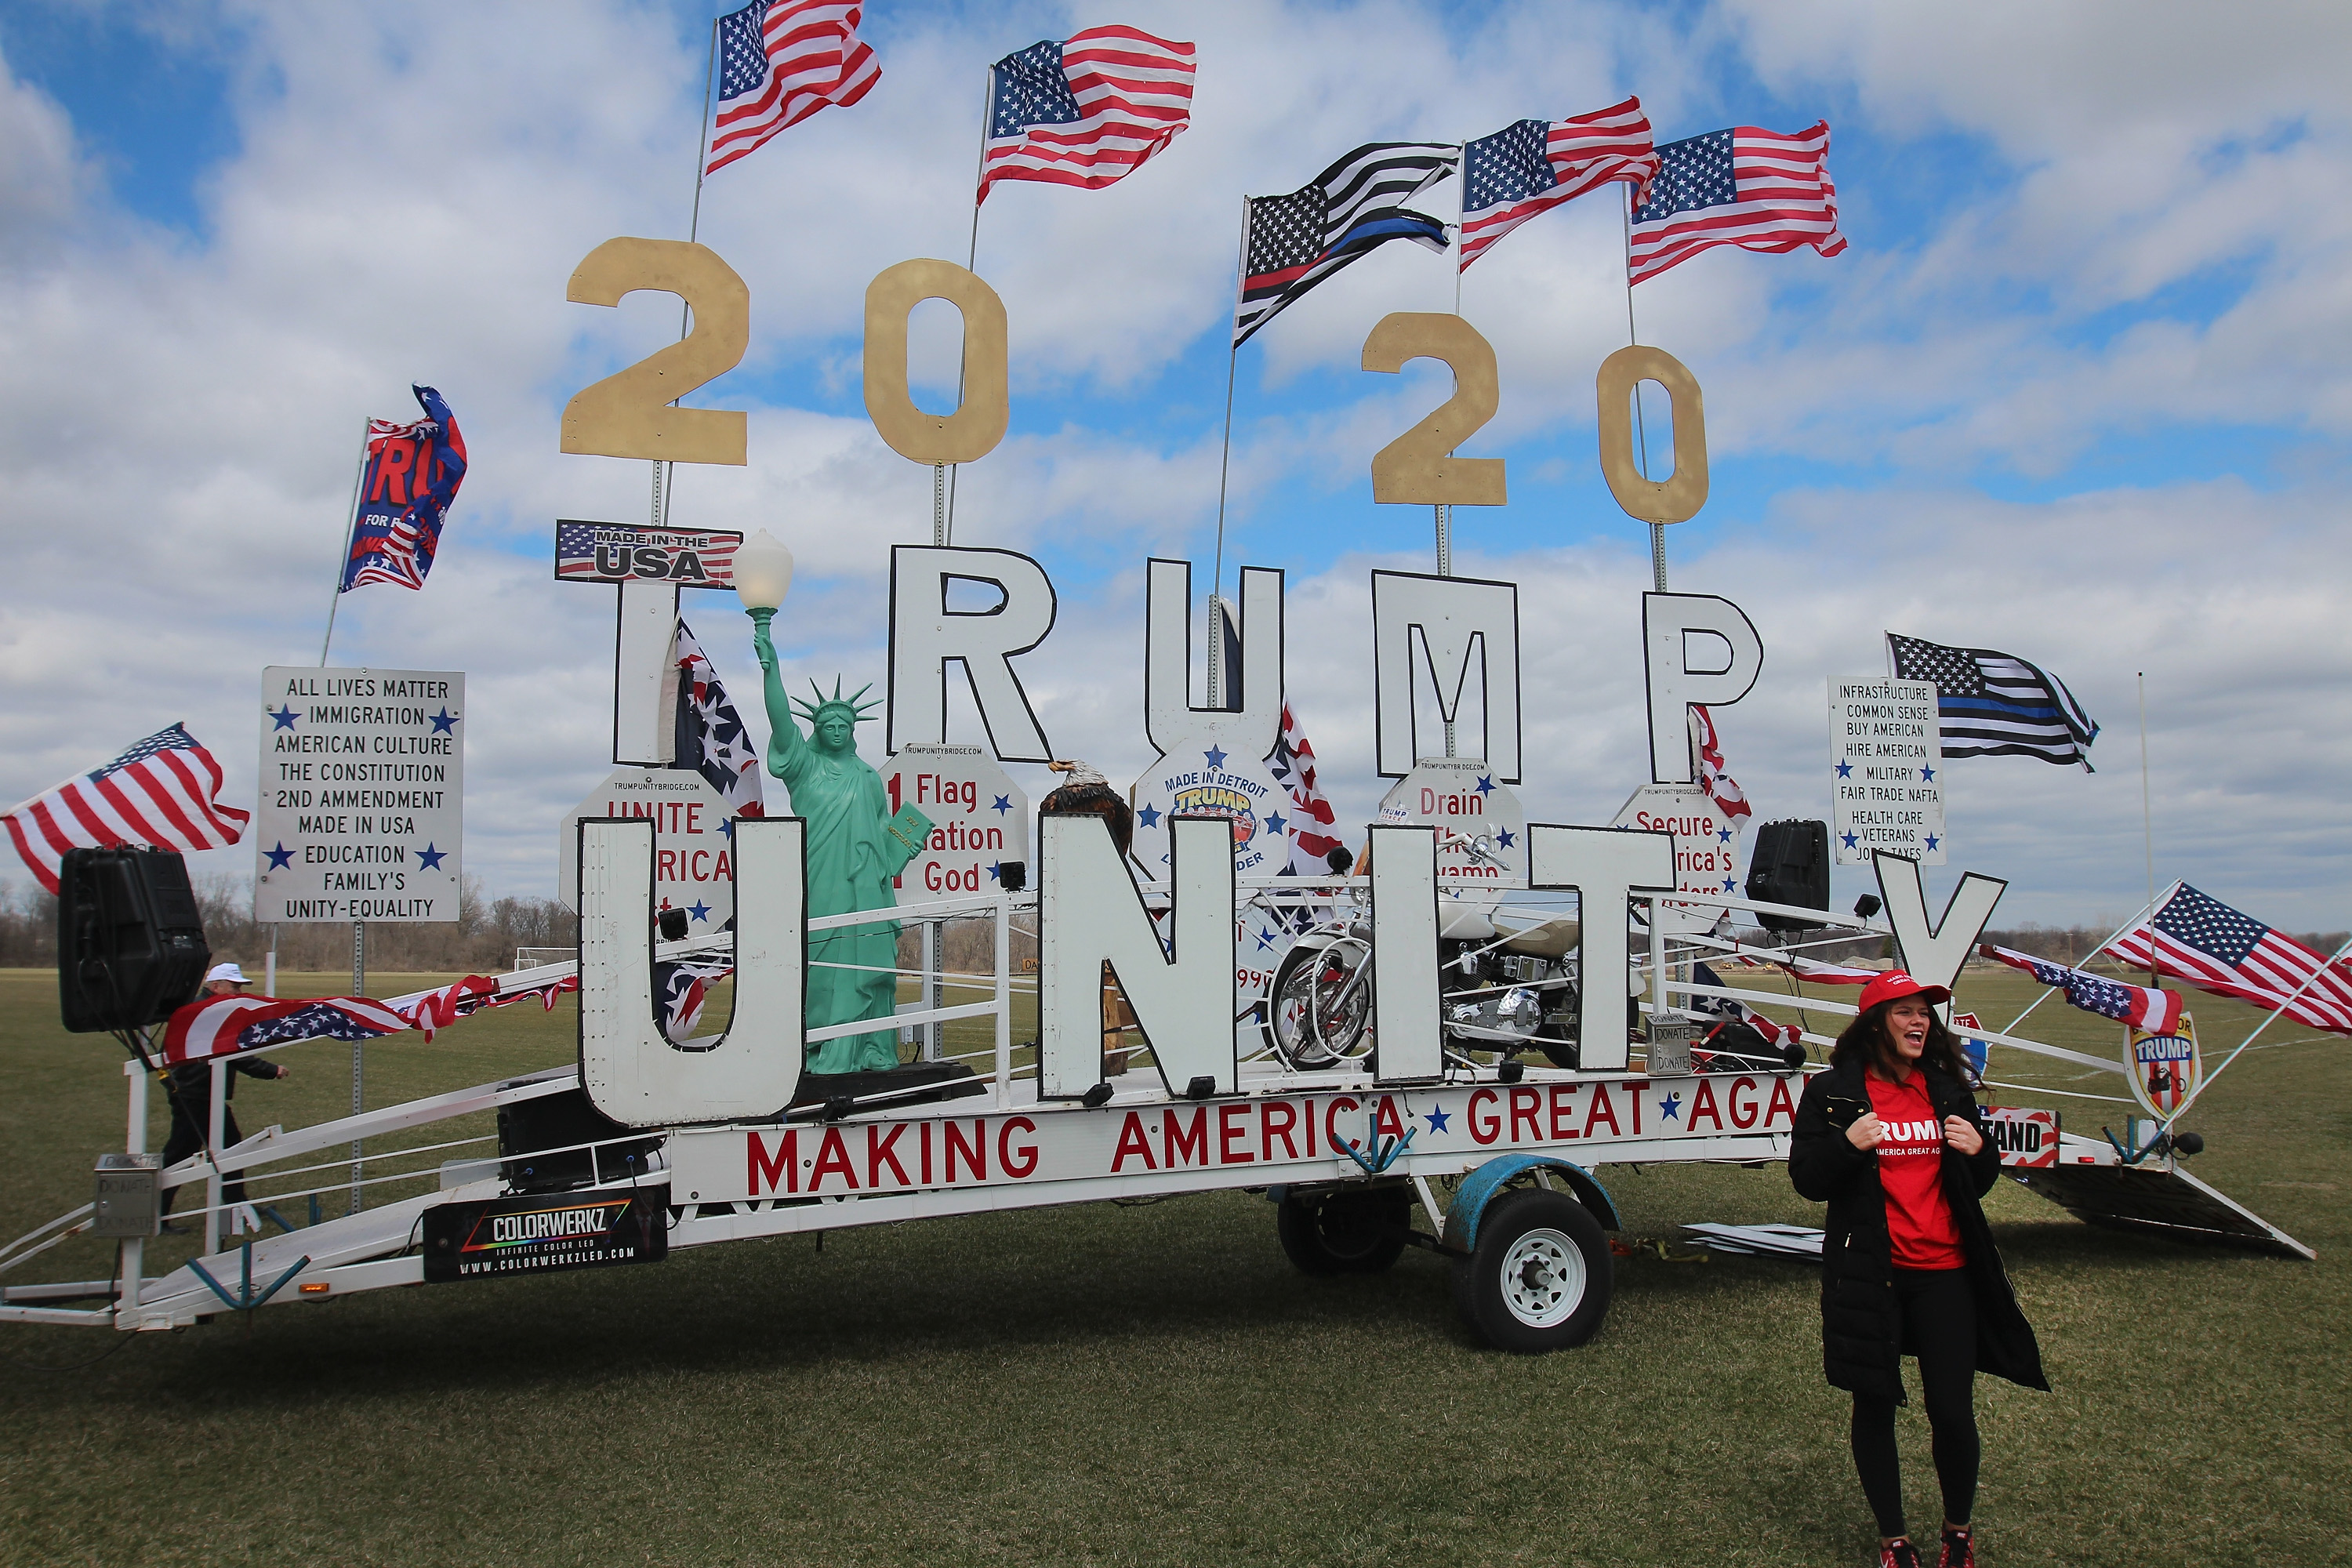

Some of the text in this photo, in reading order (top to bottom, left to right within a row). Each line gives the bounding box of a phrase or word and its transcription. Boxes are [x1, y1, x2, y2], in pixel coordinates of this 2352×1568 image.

[365, 514, 388, 527] FOR
[595, 529, 708, 547] MADE IN THE
[594, 545, 706, 580] USA
[287, 678, 448, 699] ALL LIVES MATTER
[1840, 685, 1928, 701] INFRASTRUCTURE
[310, 706, 424, 724] IMMIGRATION
[1847, 704, 1928, 720] COMMON SENSE
[1847, 723, 1924, 737] BUY AMERICAN
[275, 735, 452, 755] AMERICAN CULTURE
[905, 746, 982, 755] TRUMPUNITYBRIDGE.COM
[1846, 743, 1926, 757] HIRE AMERICAN
[280, 764, 445, 782] THE CONSTITUTION
[1867, 767, 1913, 781] MILITARY
[615, 782, 699, 791] TRUMPUNITYBRIDGE.COM
[917, 774, 977, 813] Flag
[1164, 772, 1269, 798] MADE IN DETROIT
[277, 790, 444, 808] 2ND AMMENDMENT
[1175, 787, 1251, 811] TRUMP
[1421, 788, 1483, 815] Drain
[1841, 786, 1939, 803] FAIR TRADE NAFTA
[1382, 808, 1406, 817] TRUMP
[1852, 811, 1922, 825] HEALTH CARE
[299, 816, 415, 834] MADE IN USA
[1636, 811, 1713, 836] Secure
[923, 821, 1003, 851] ation
[1862, 828, 1915, 842] VETERANS
[306, 845, 405, 863] EDUCATION
[1236, 851, 1264, 872] DER
[1677, 846, 1733, 872] rica's
[1857, 848, 1921, 861] JO TAXES
[658, 850, 733, 882] RICA
[325, 873, 405, 891] FAMILY'S
[924, 861, 979, 891] God
[286, 899, 434, 918] UNITY-EQUALITY
[1237, 968, 1274, 989] 99
[1657, 1028, 1690, 1040] DONATE
[2136, 1038, 2191, 1060] TRUMP
[1658, 1056, 1689, 1069] DONATE
[747, 1073, 1810, 1196] MAKING AMERICA GREAT AGA
[1878, 1120, 1944, 1142] RUM
[1980, 1120, 2041, 1153] AND
[493, 1207, 607, 1242] COLORWERKZ
[496, 1240, 594, 1256] INFINITE COLOR LED
[460, 1247, 635, 1274] WWW.COLORWERKZLED.COM
